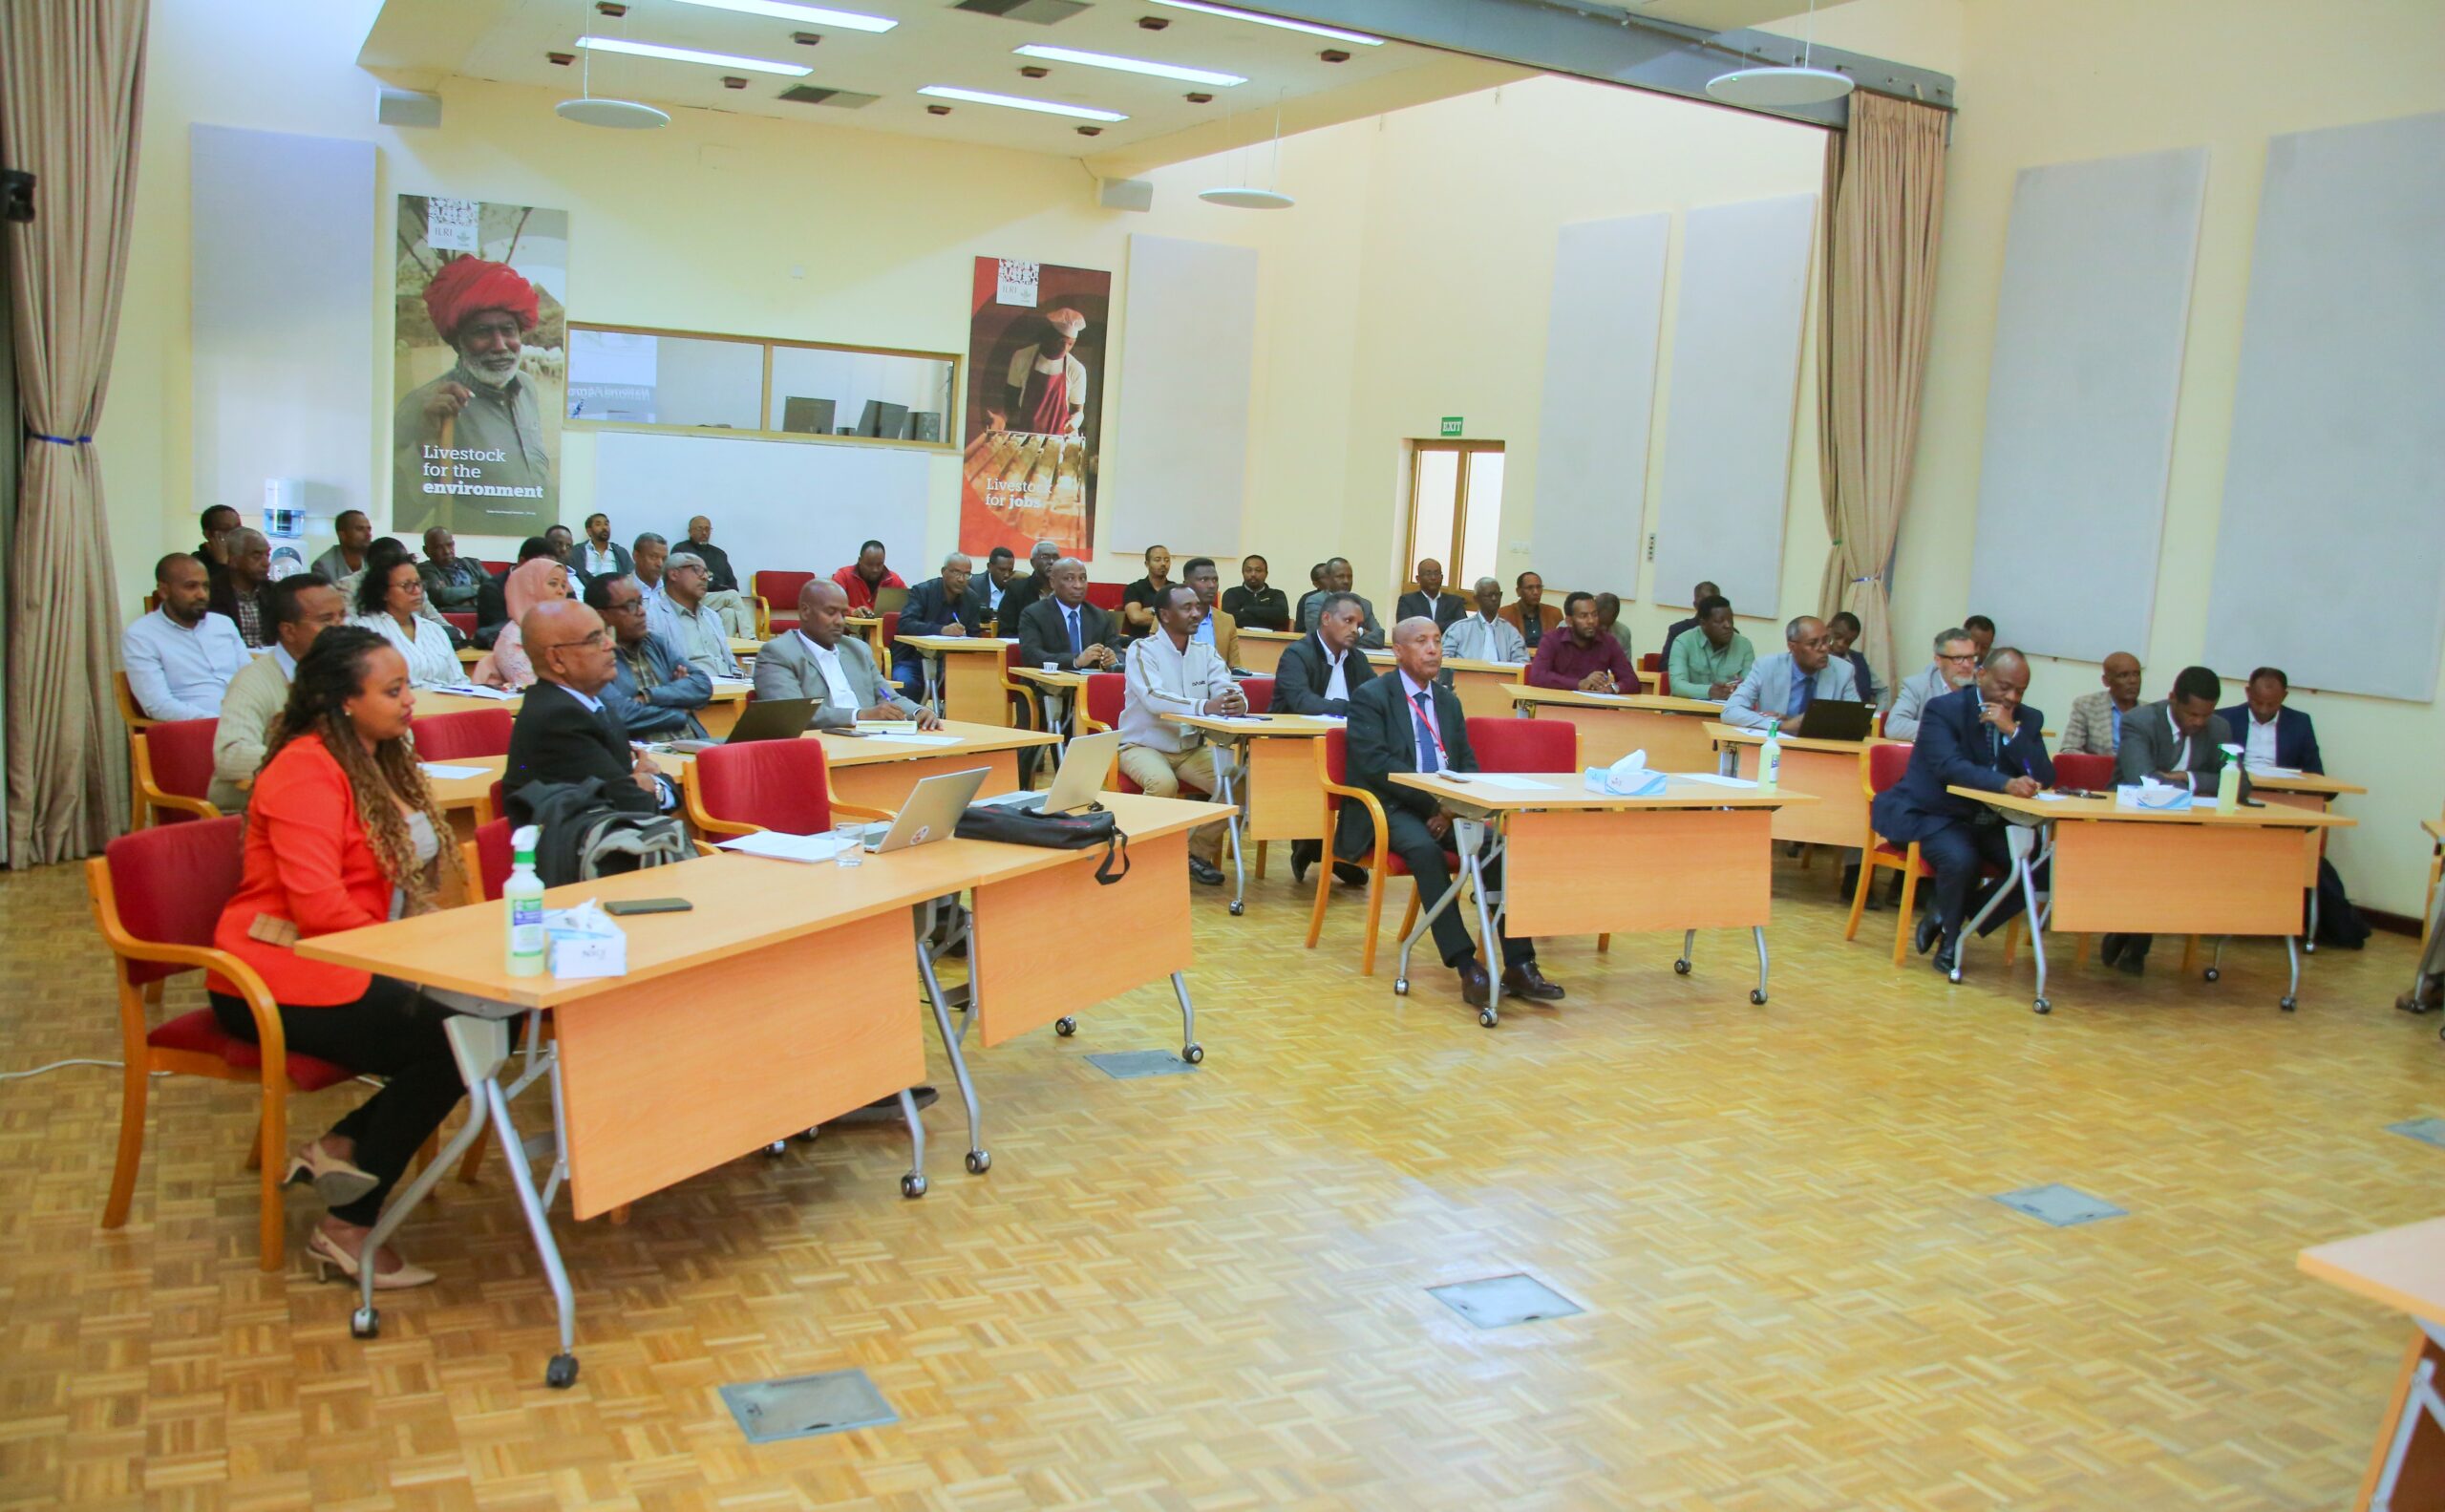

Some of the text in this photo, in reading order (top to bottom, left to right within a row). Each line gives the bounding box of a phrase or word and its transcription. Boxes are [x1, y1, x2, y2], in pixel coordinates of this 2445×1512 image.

[436, 227, 453, 237] ILRI
[1443, 421, 1461, 432] EXIT
[423, 445, 506, 462] Livestock
[423, 462, 481, 478] for the
[422, 480, 543, 498] environment
[987, 478, 1052, 494] Livestok
[985, 493, 1006, 506] for
